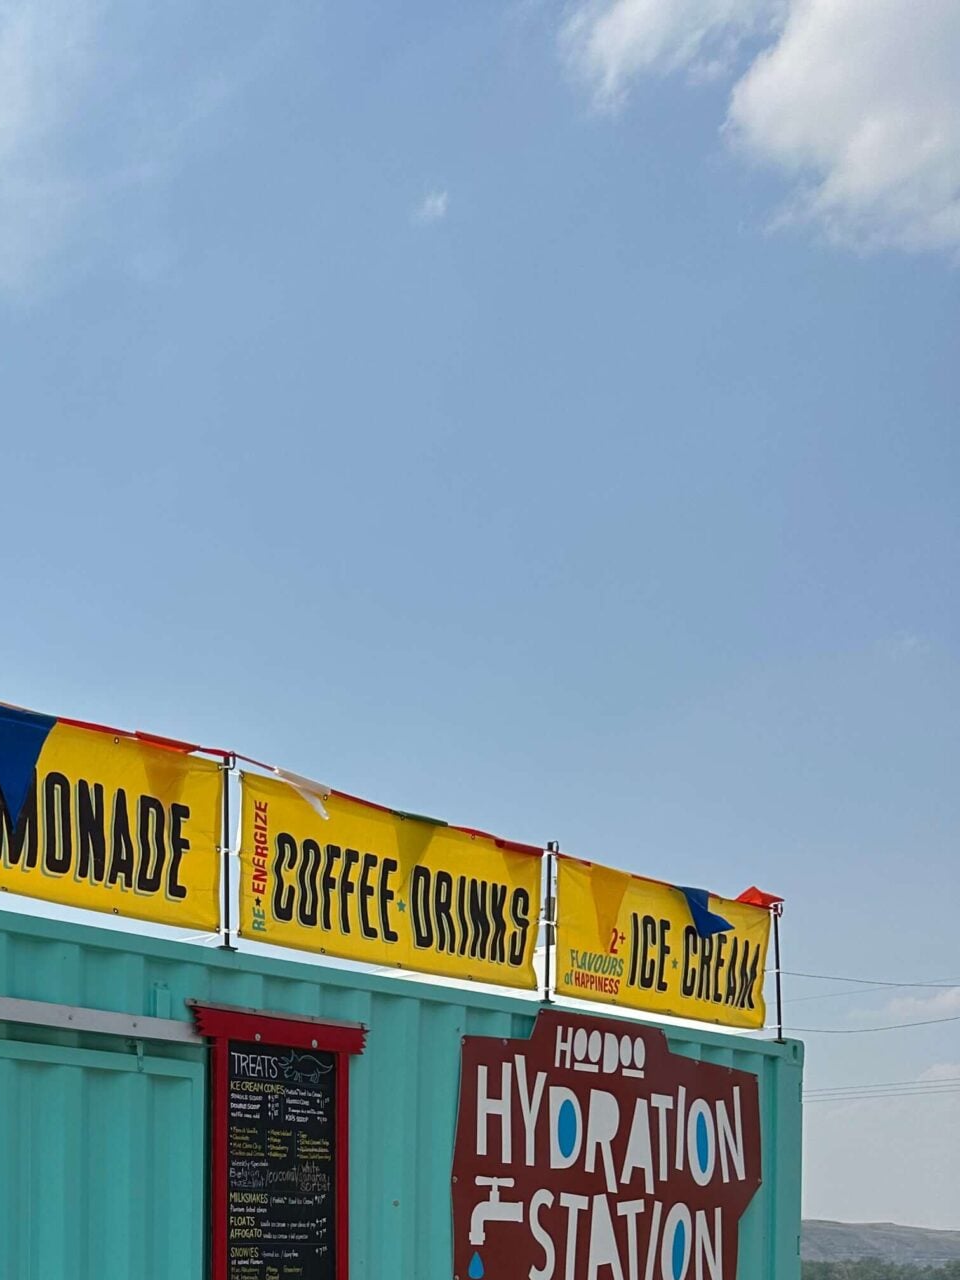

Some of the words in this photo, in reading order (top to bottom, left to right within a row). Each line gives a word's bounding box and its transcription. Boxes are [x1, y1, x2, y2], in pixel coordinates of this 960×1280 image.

[252, 800, 268, 895] ENERGIZE
[272, 832, 398, 942] COFFEE
[411, 864, 530, 966] DRINKS
[609, 927, 626, 954] 2+
[570, 948, 624, 976] FLAVOURS
[627, 912, 670, 992] ICE
[681, 925, 761, 1010] CREAM
[574, 973, 620, 995] HAPPINESS
[230, 1051, 279, 1079] TREATS
[554, 1025, 645, 1078] HOODOO
[230, 1081, 240, 1091] ICE
[240, 1081, 263, 1093] CREAM
[263, 1084, 285, 1096] CONES
[476, 1054, 746, 1194] HYDRATION
[230, 1192, 268, 1204] MILKSHAKES
[230, 1216, 255, 1227] FLOATS
[230, 1228, 262, 1239] AFFOGATO
